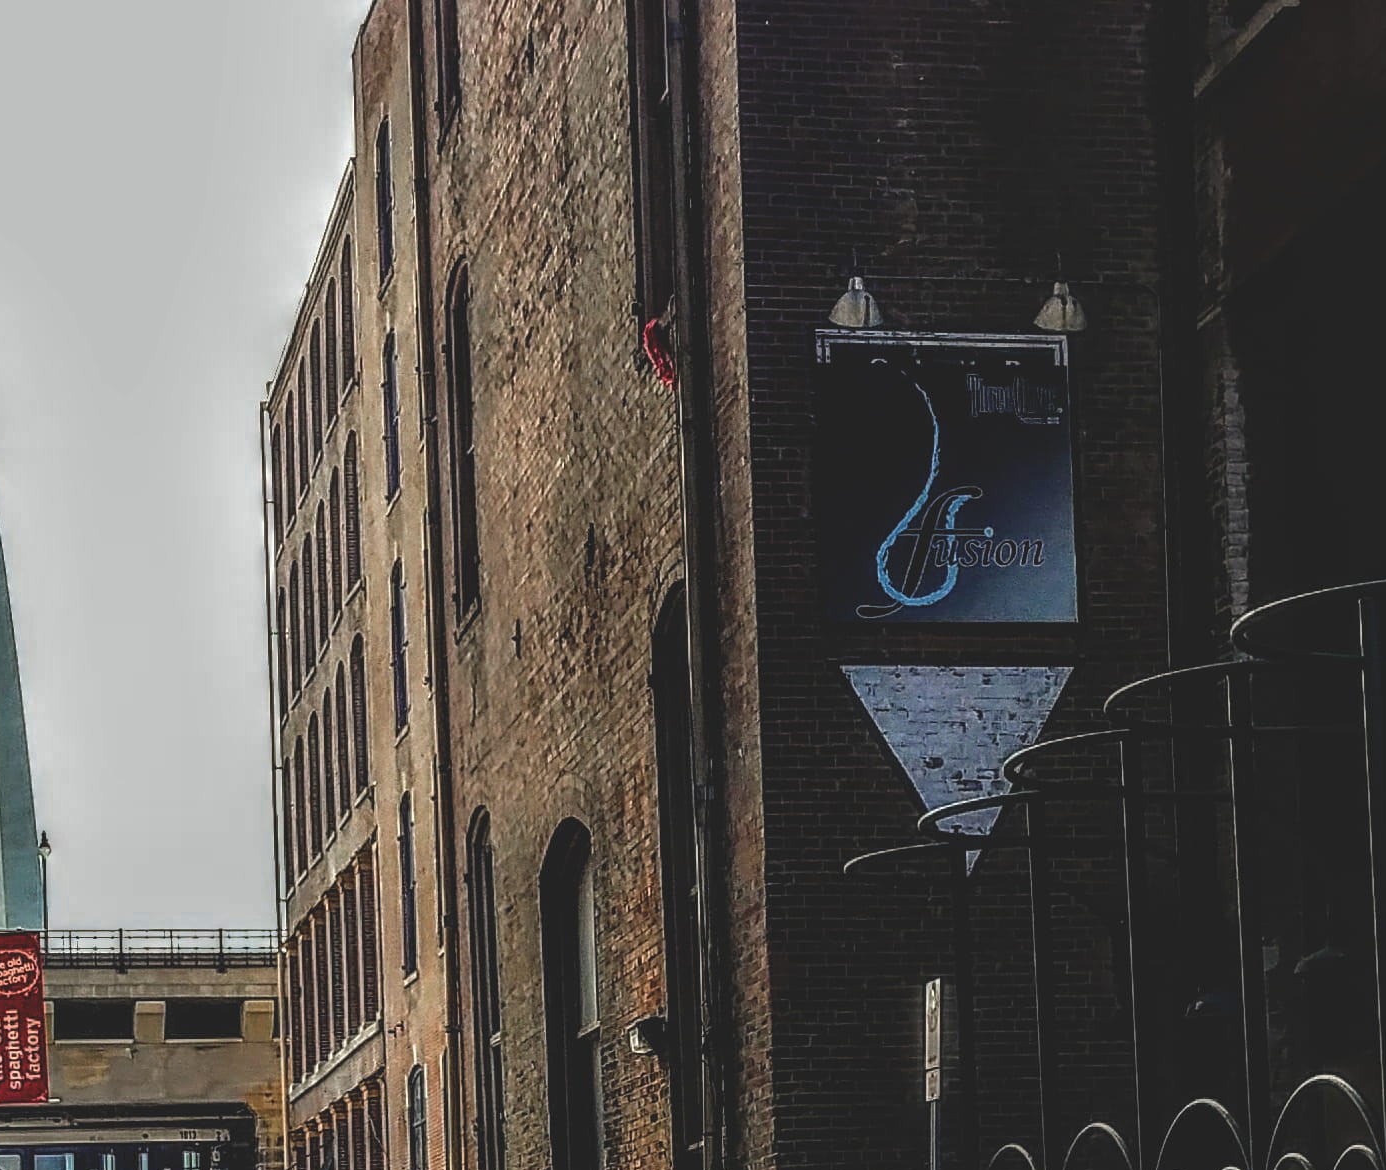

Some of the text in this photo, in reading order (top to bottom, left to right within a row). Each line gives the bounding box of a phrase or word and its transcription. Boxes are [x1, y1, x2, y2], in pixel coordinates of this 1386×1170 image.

[856, 486, 1045, 618] fusion
[7, 956, 22, 967] old
[3, 1009, 25, 1090] spaghetti
[23, 1017, 41, 1079] factory
